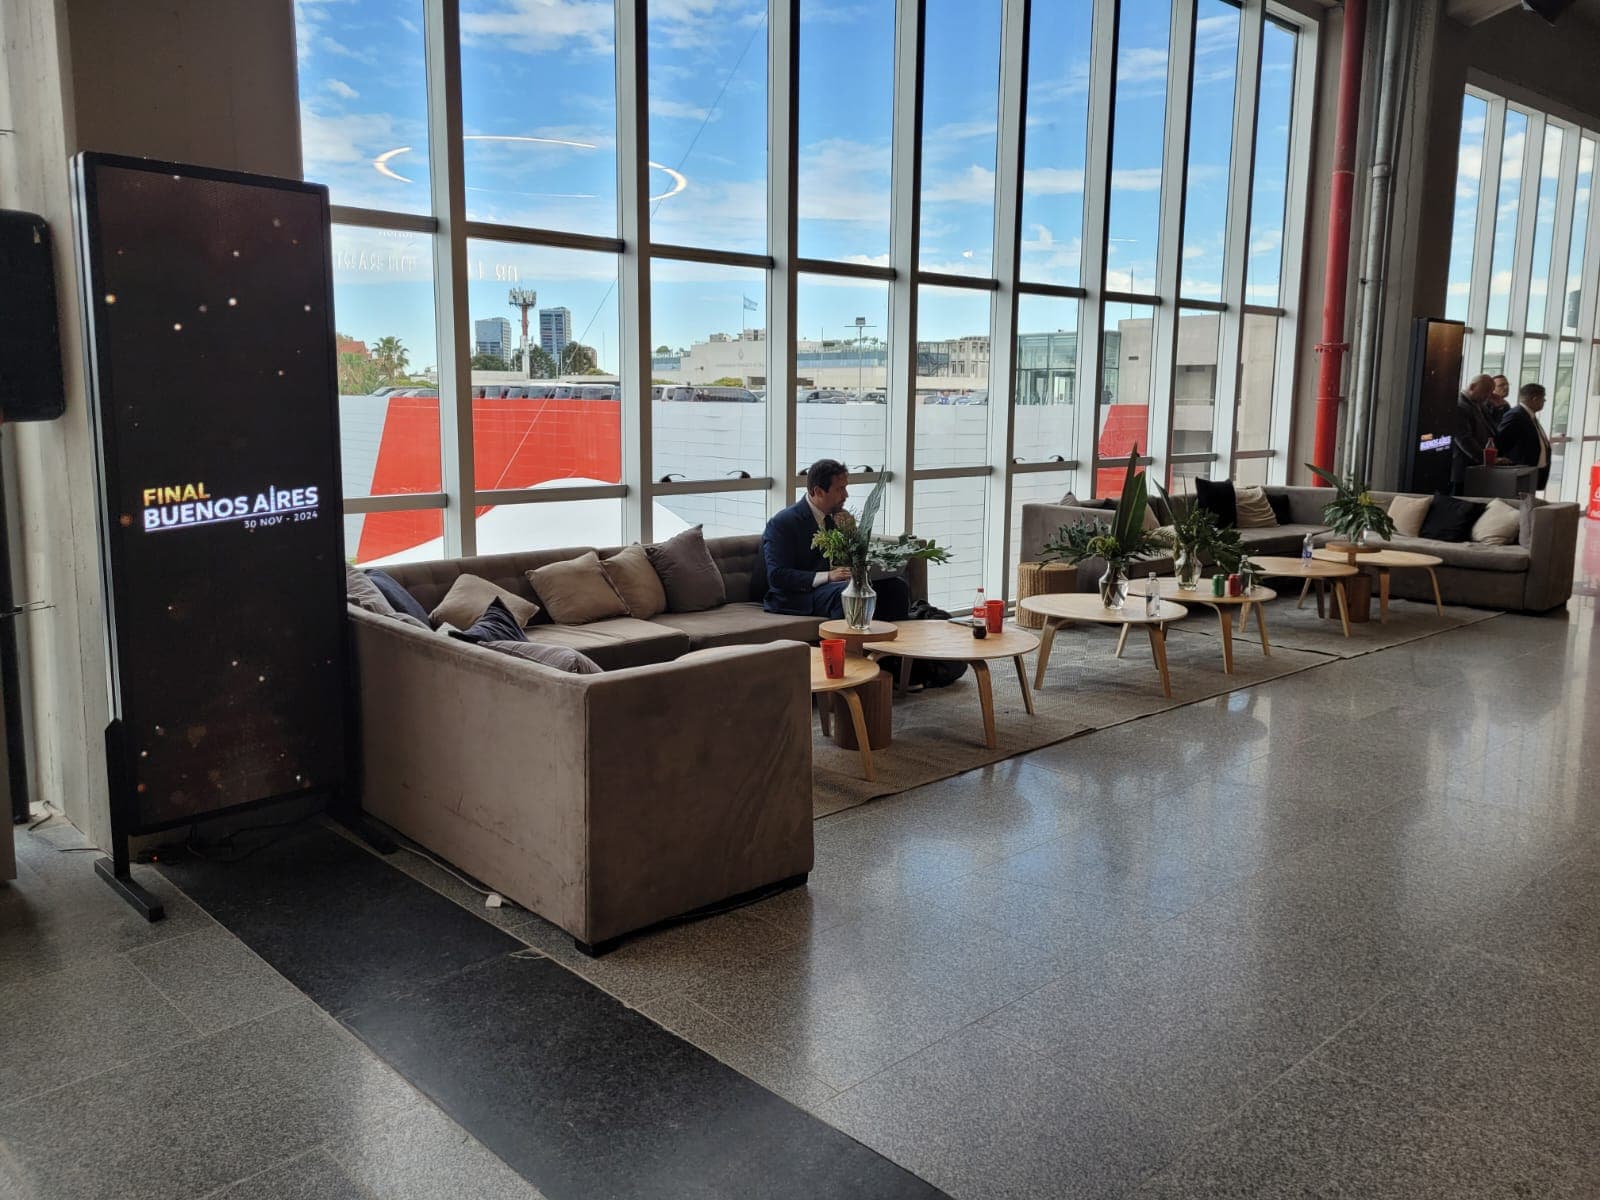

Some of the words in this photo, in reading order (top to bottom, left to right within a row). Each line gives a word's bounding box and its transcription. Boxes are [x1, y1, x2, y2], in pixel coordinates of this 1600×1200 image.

[143, 482, 210, 506] FINAL
[143, 496, 249, 529] BUENOS
[253, 485, 319, 513] AIRES
[244, 520, 257, 529] 30
[260, 516, 283, 527] NOV
[294, 511, 319, 523] 2024
